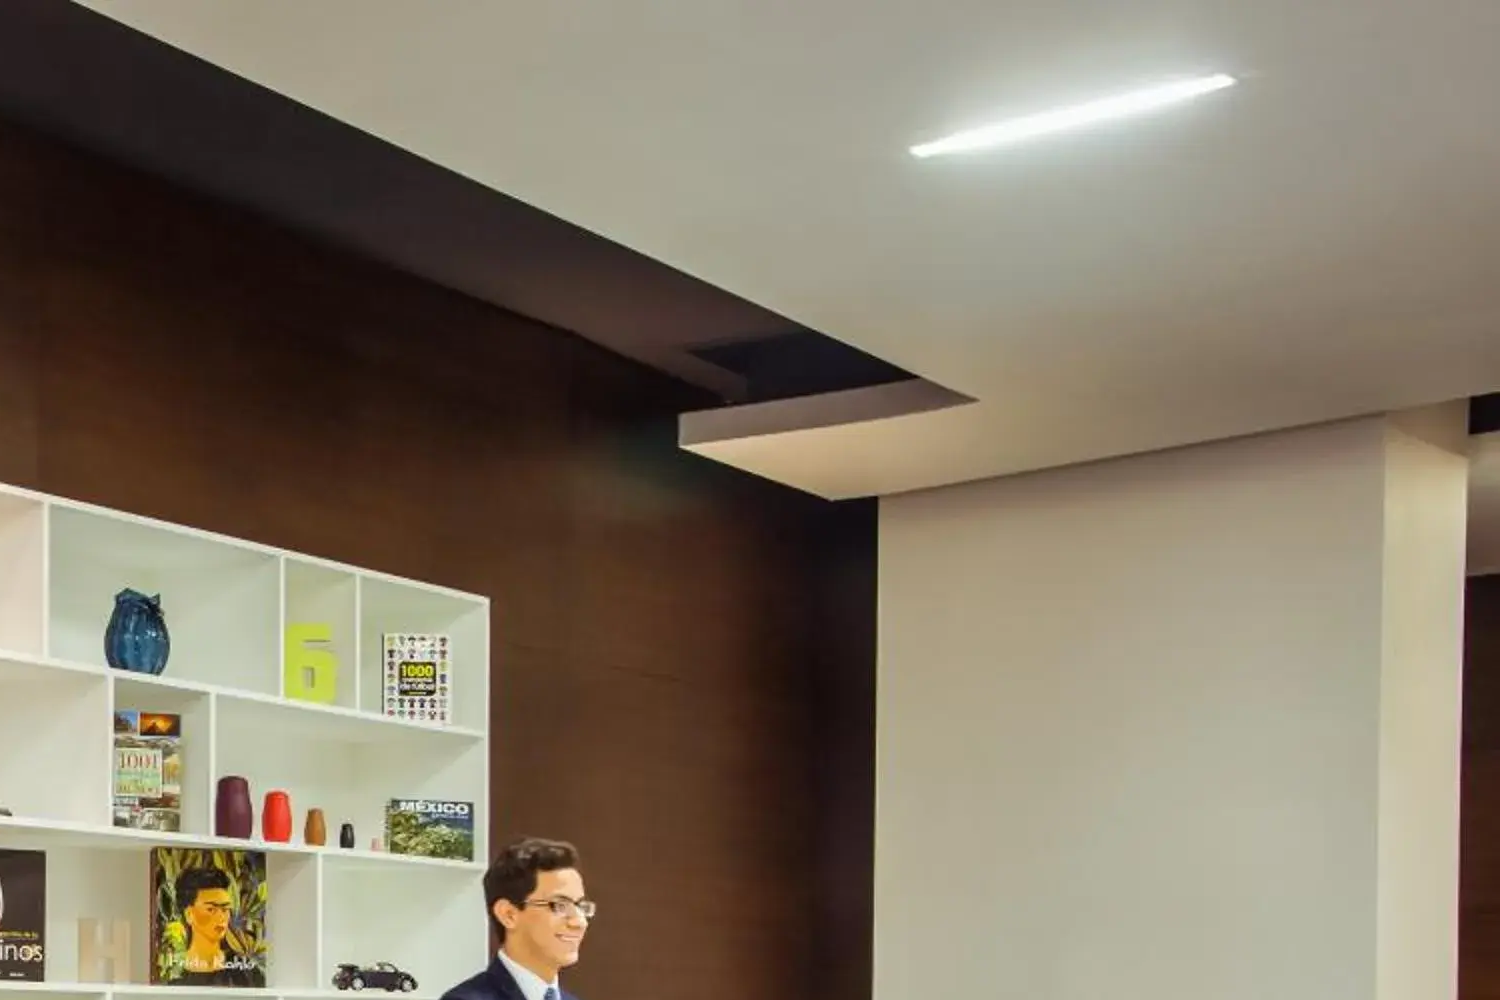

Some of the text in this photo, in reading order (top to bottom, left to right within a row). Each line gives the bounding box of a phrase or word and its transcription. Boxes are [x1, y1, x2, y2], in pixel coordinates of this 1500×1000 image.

[285, 622, 336, 704] 6
[401, 664, 435, 678] 1000
[398, 800, 470, 816] MÉXICO
[78, 917, 131, 983] H
[213, 954, 256, 971] Kahlo
